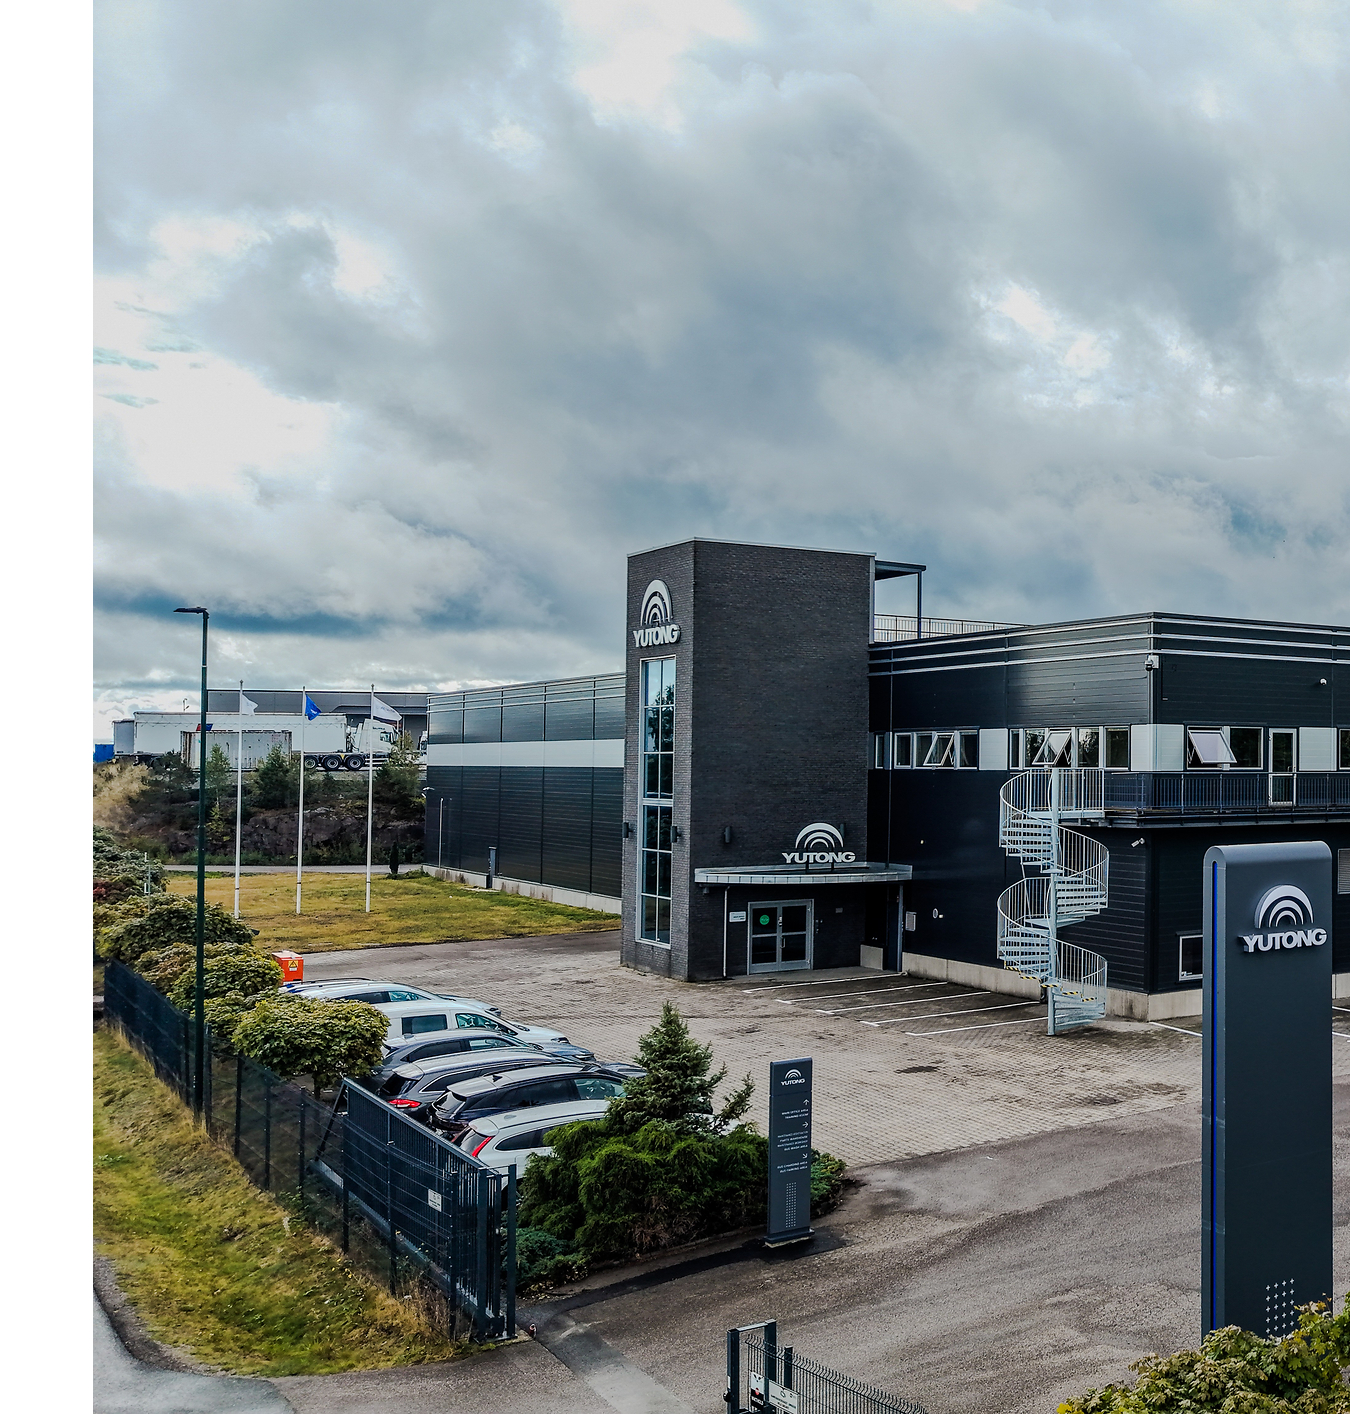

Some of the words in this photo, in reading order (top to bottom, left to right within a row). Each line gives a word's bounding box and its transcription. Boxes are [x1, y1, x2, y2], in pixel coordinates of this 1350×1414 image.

[633, 624, 680, 647] YUTONG
[781, 851, 856, 864] YUTONG
[1239, 928, 1328, 953] YUTONG
